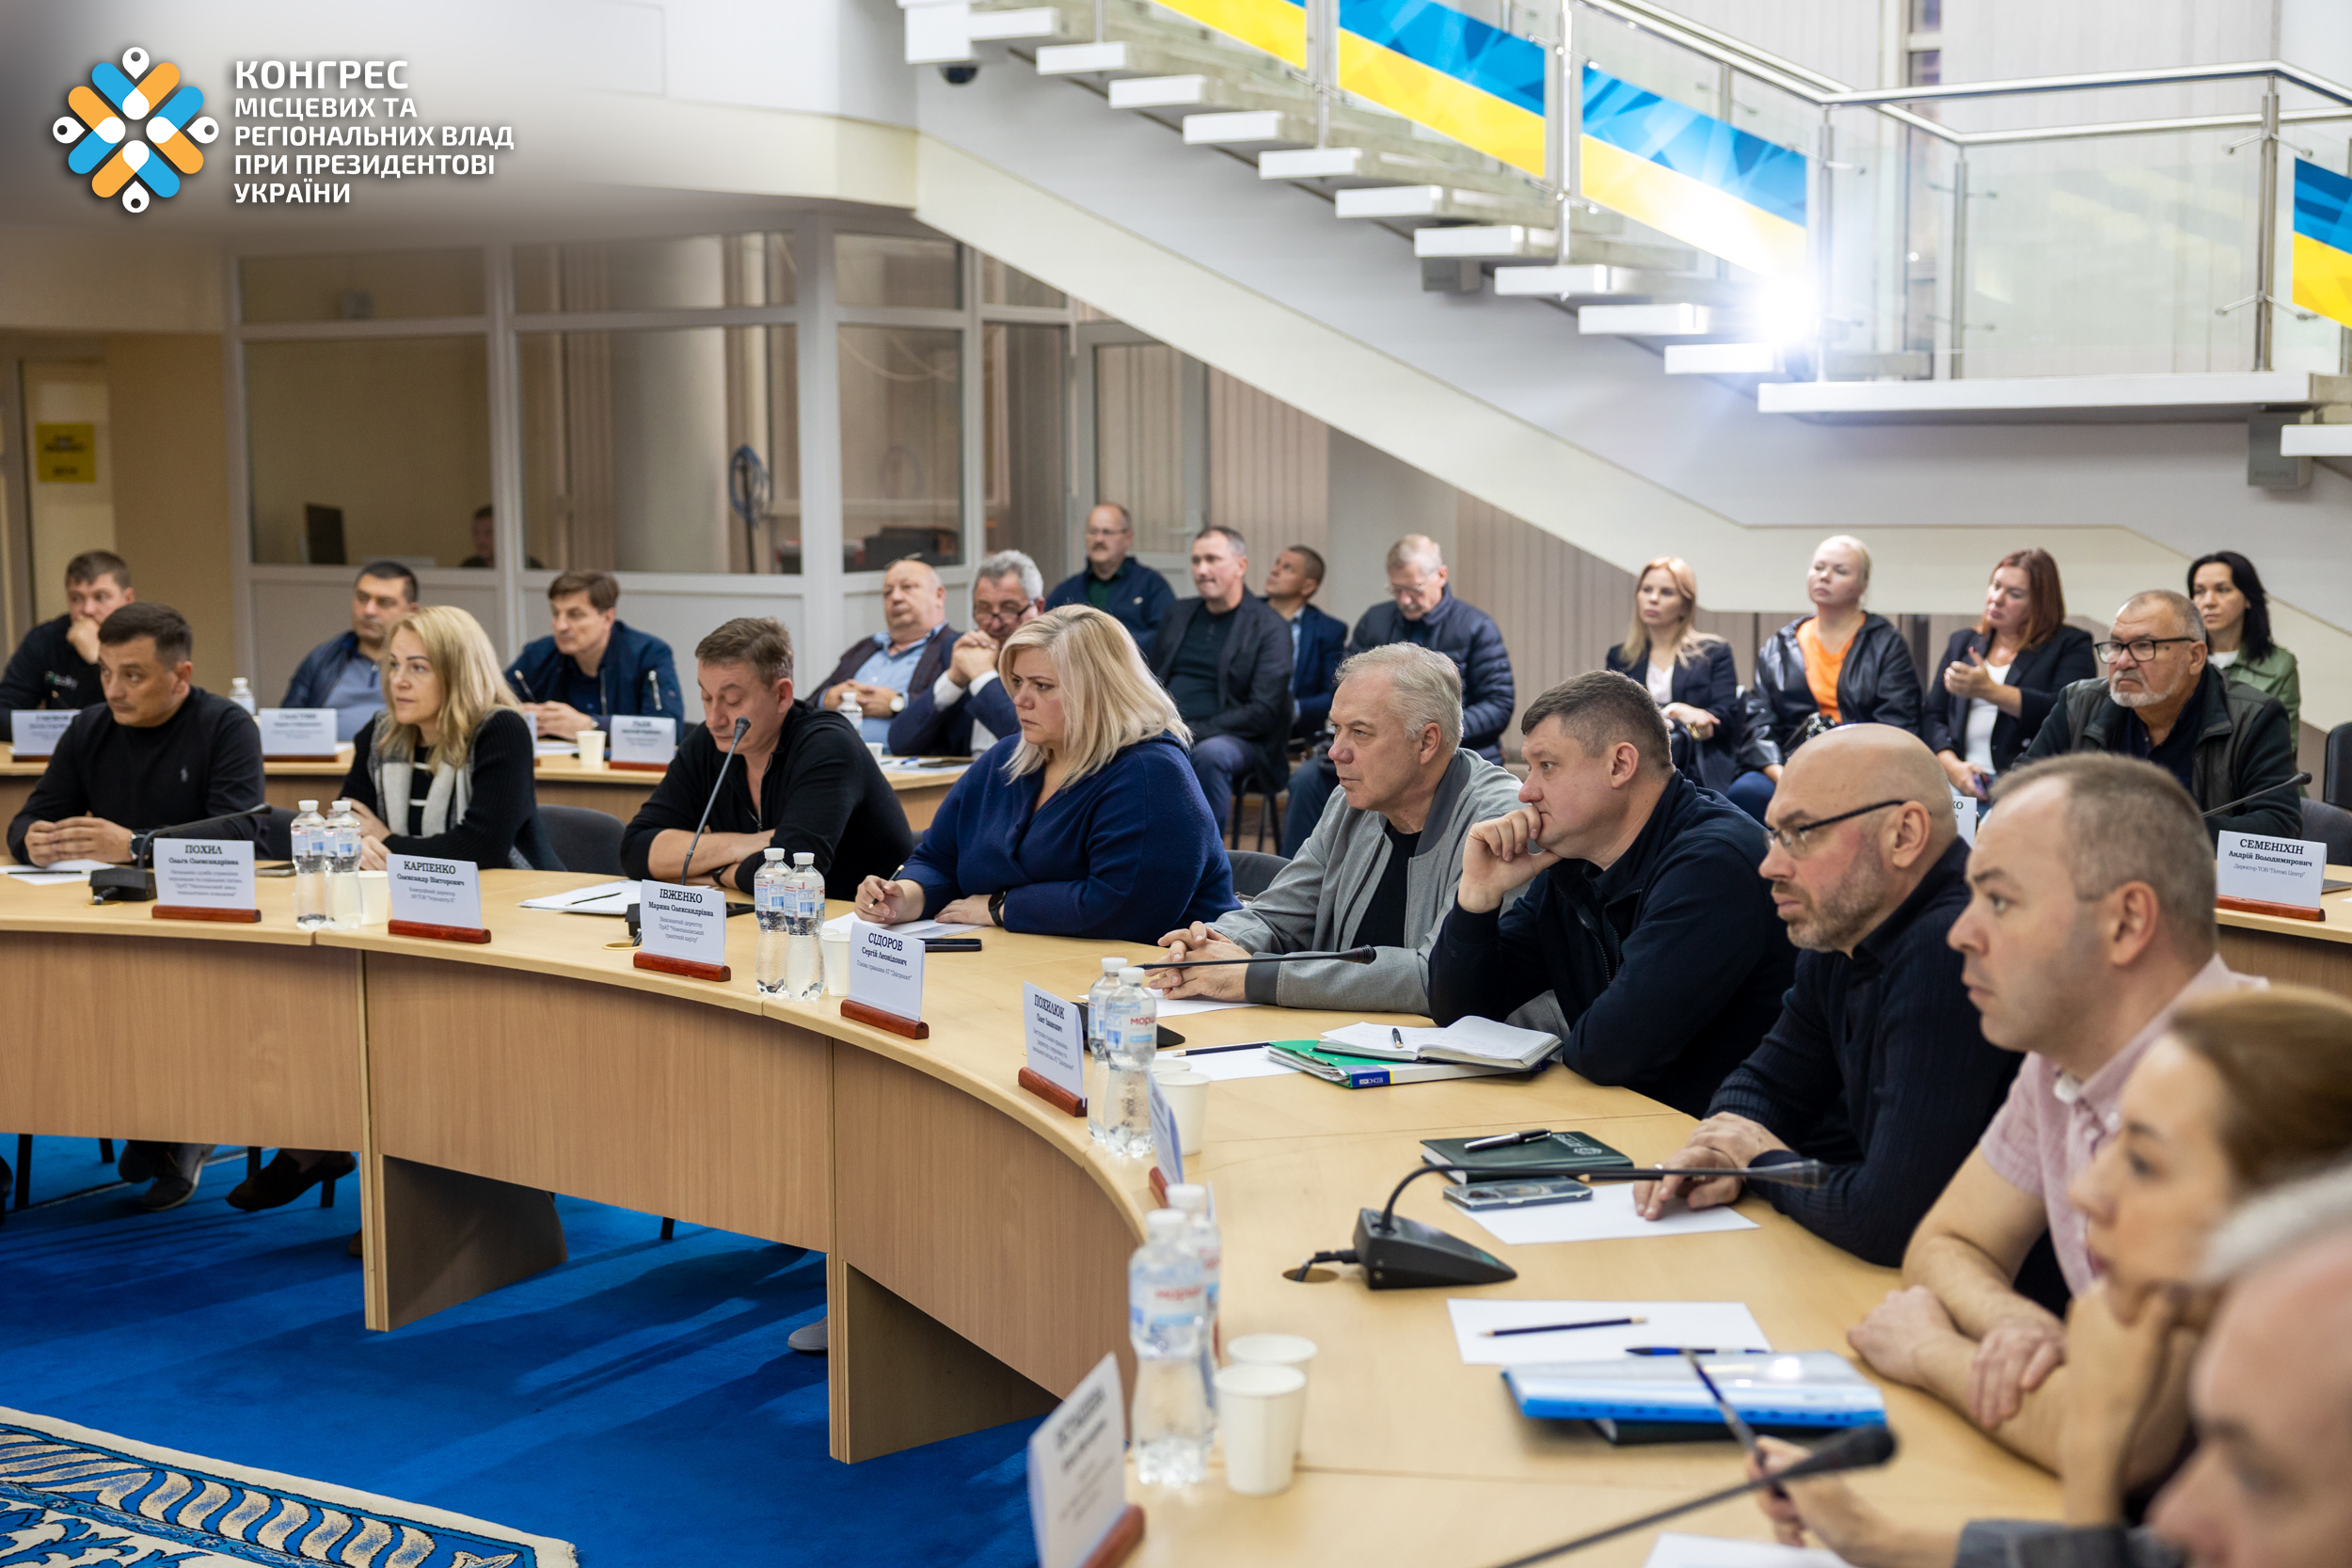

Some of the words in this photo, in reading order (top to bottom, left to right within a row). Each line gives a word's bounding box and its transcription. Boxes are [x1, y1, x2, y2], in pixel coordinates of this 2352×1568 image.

[185, 845, 222, 854] ПОХИЛ
[2240, 839, 2304, 855] СЕМЕНІХІН
[2228, 850, 2254, 860] Андрій
[2255, 854, 2312, 867] Володимирович
[404, 861, 456, 874] КАРПЕНКО
[397, 873, 429, 884] Олександр
[430, 876, 465, 886] Вікторович
[660, 888, 702, 903] ІВЖЕНКО
[648, 901, 670, 911] Марина
[671, 904, 714, 917] Олександрівна
[868, 933, 903, 951] СІДОРОВ
[862, 947, 877, 958] Сергій
[879, 951, 907, 966] Леонідович
[1035, 994, 1065, 1019] ПОХИЛЮК
